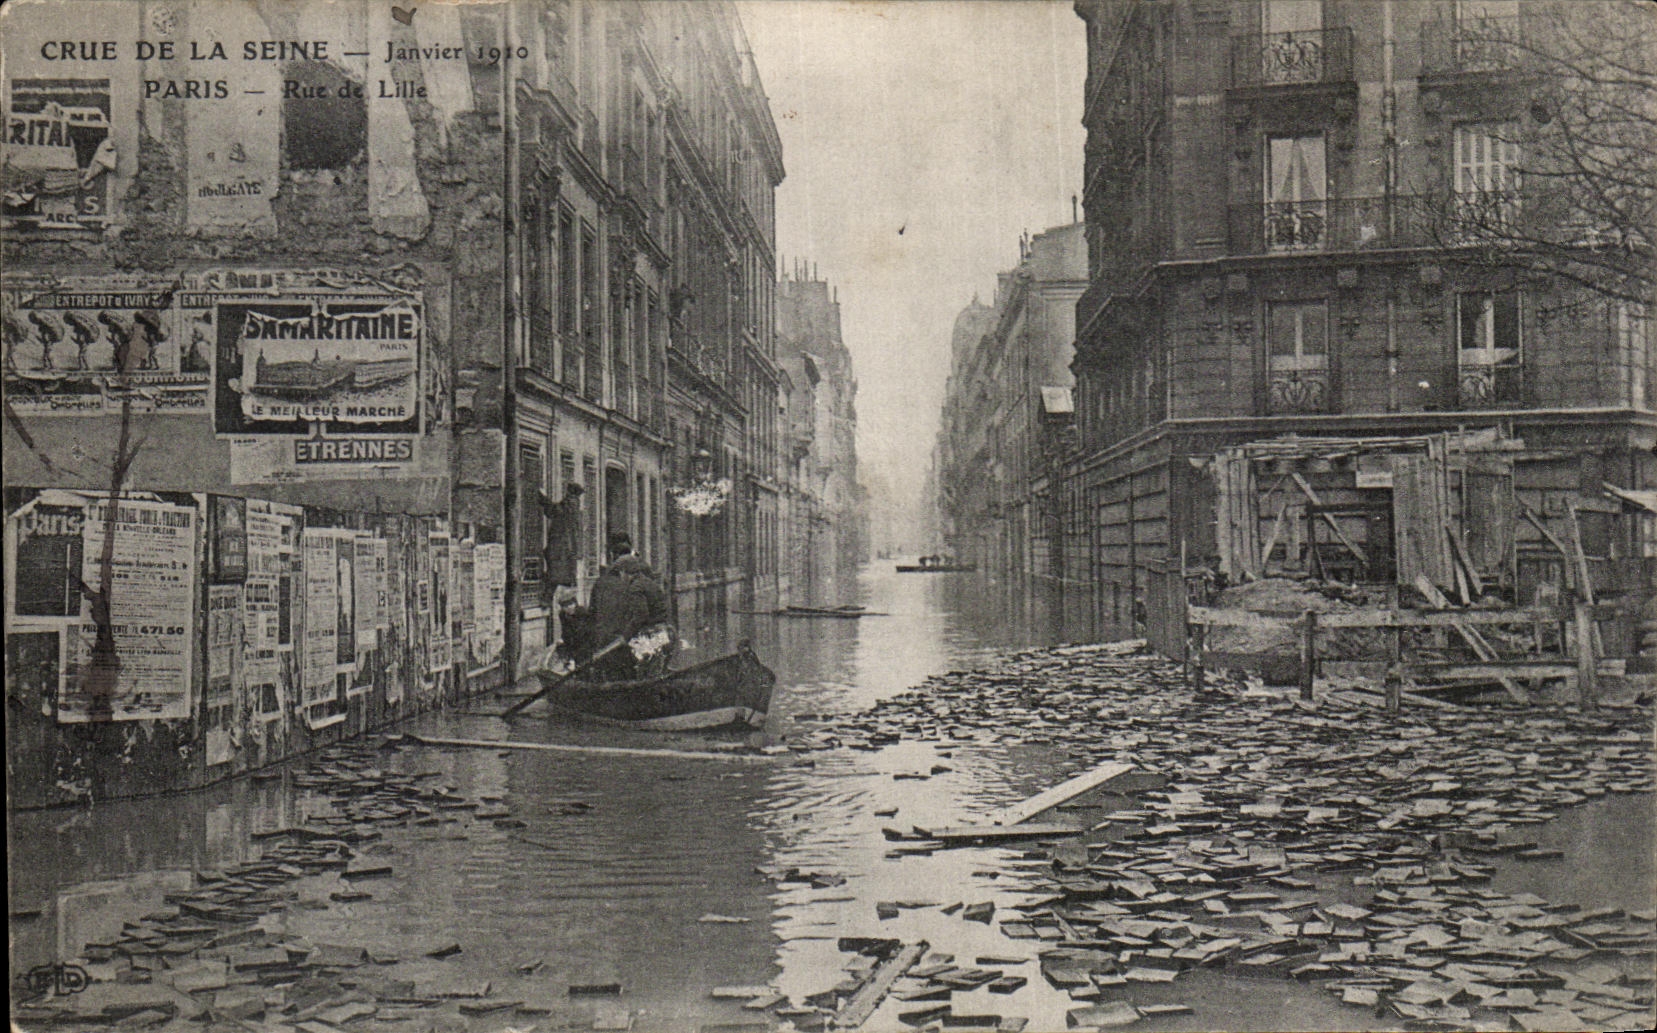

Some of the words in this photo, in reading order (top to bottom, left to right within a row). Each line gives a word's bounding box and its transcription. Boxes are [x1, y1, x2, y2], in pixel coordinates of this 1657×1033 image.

[245, 313, 413, 340] SAMARITAINE
[379, 342, 409, 351] PARIS
[270, 404, 340, 417] MEILLEUR
[296, 440, 411, 461] ETRENNES
